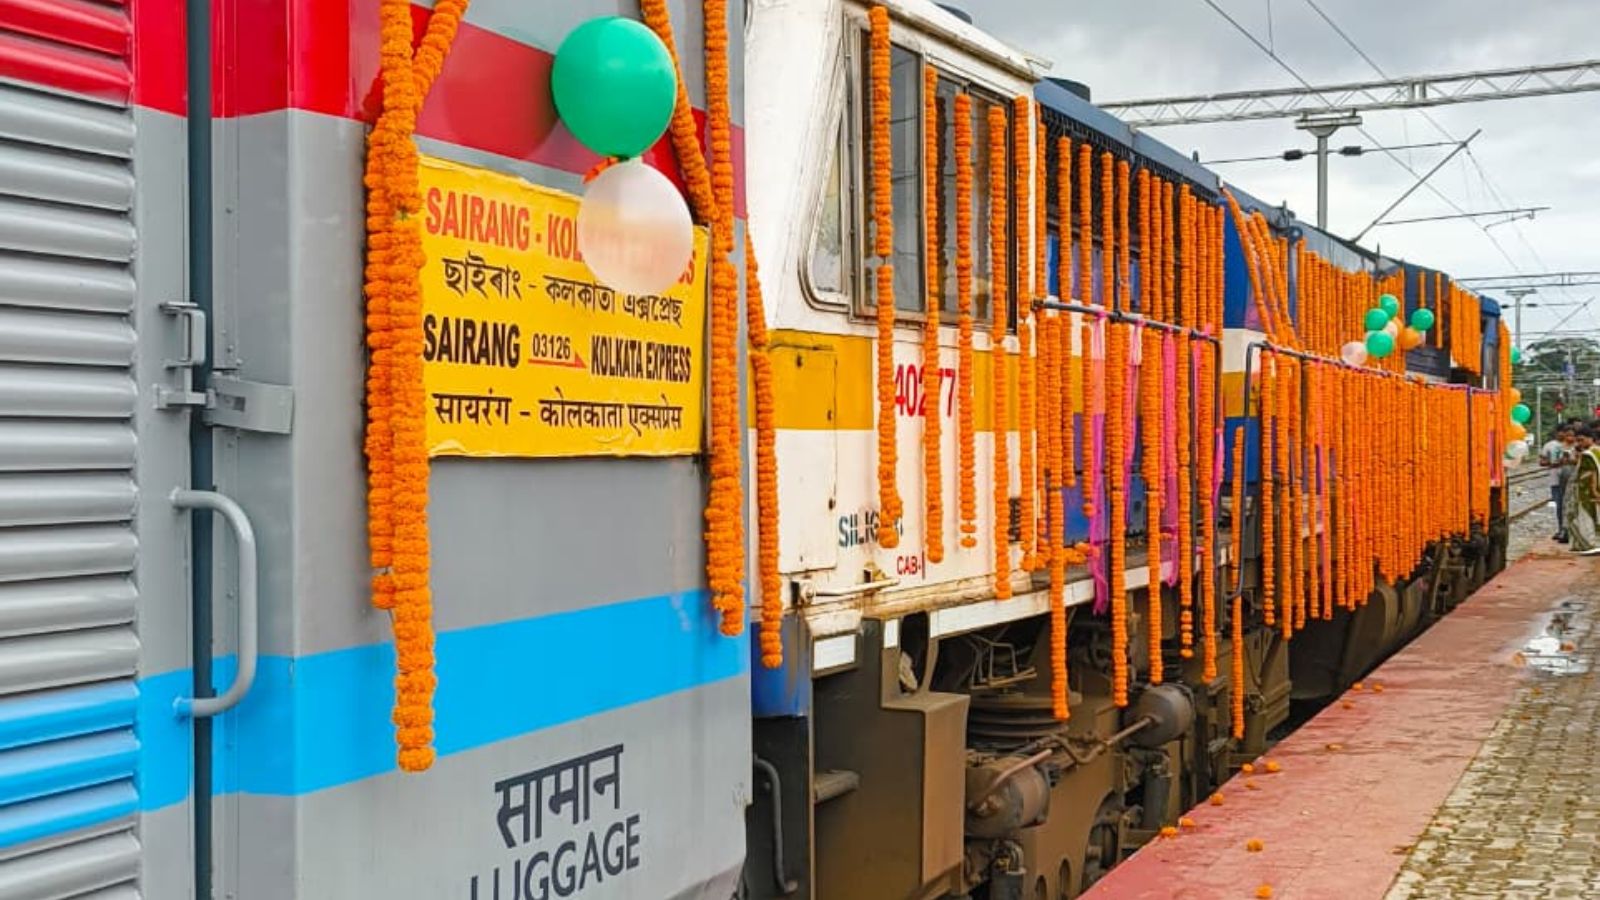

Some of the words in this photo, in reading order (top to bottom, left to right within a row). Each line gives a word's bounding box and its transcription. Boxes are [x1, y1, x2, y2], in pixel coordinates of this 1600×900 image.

[425, 187, 530, 251] SAIRANG
[543, 274, 615, 315] কলকাতা
[423, 314, 520, 368] SAIRANG
[532, 333, 571, 360] 03126
[591, 335, 643, 378] KOLKATA
[646, 342, 692, 384] EXPRESS
[432, 388, 512, 426] सायरंग
[539, 386, 624, 429] कोलकाता
[627, 394, 683, 437] एक्सप्रेस
[494, 743, 624, 849] सामान
